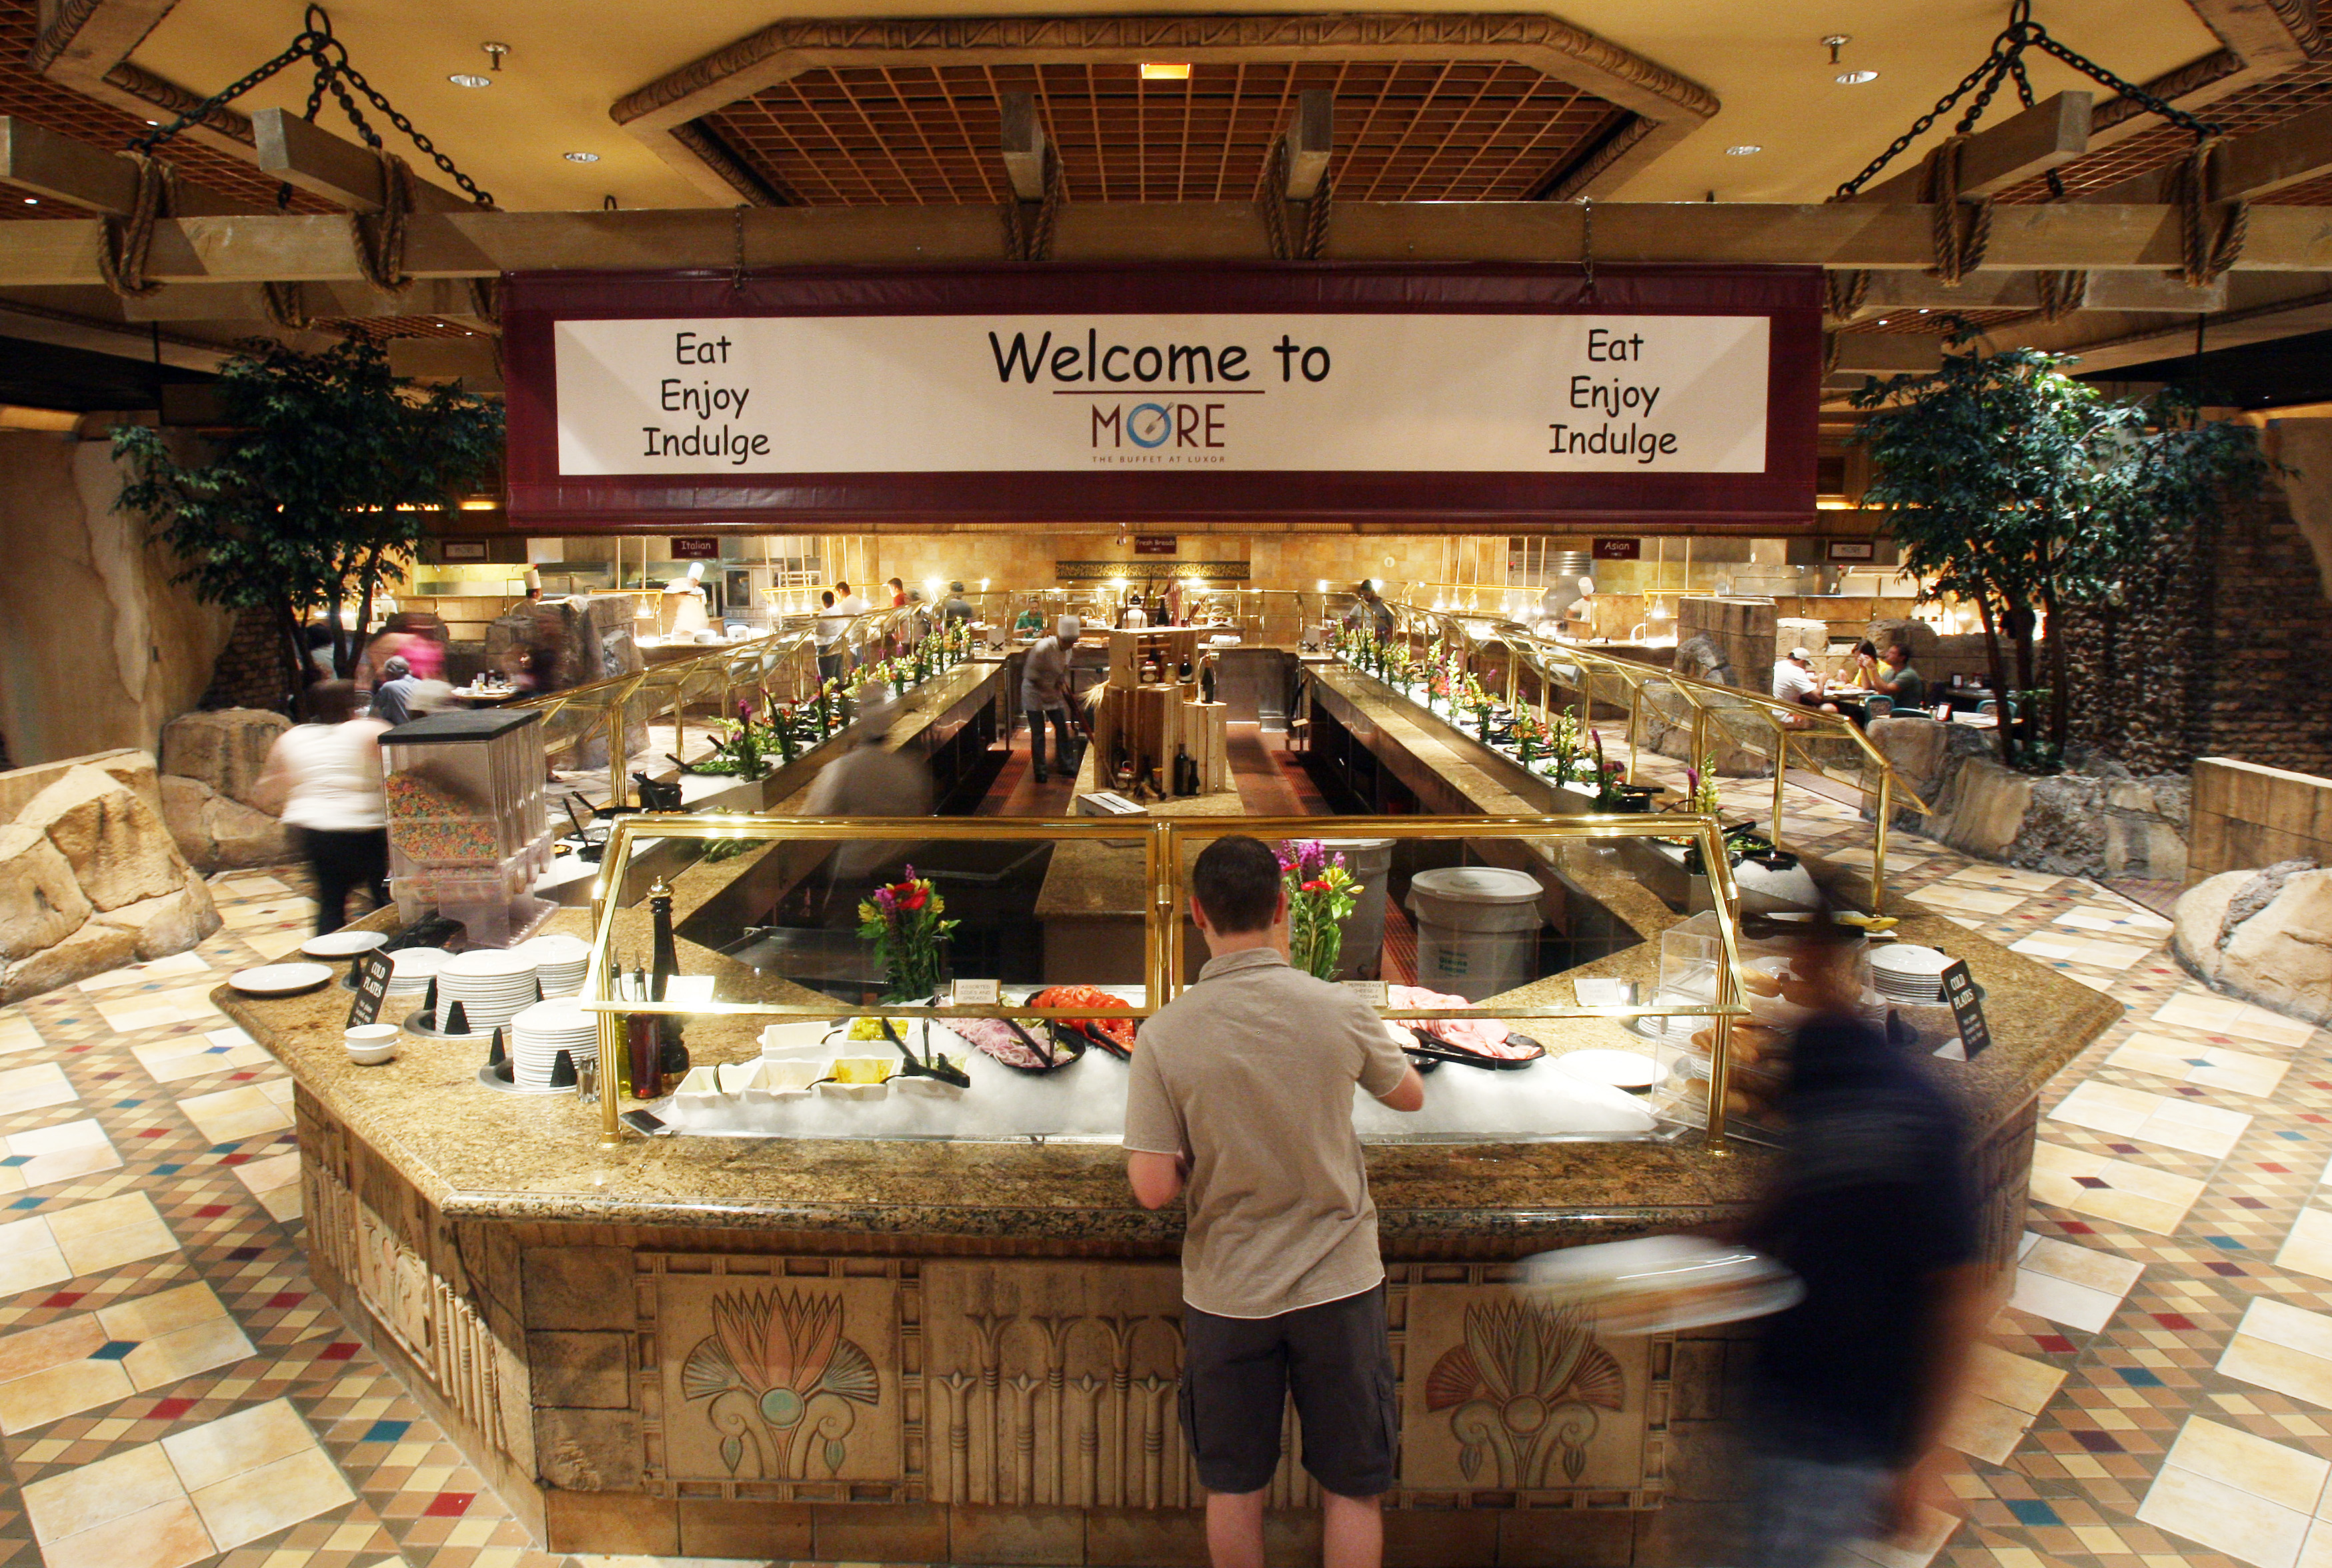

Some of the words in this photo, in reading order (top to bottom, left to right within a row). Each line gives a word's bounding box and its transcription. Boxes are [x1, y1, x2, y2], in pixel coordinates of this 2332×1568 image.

[676, 332, 732, 365] Eat
[988, 327, 1250, 384] Welcome
[1272, 334, 1331, 383] to
[1587, 329, 1644, 361] Eat
[661, 379, 750, 420] Enjoy
[1570, 375, 1660, 418] Enjoy
[1092, 402, 1226, 449] MORE
[642, 424, 770, 465] Indulge
[1120, 455, 1162, 463] BUFFET
[1549, 423, 1678, 464] Indulge
[681, 541, 712, 550] Italian
[1604, 541, 1630, 550] Asian
[371, 961, 385, 979] COLD
[1950, 973, 1966, 990] COLD
[363, 976, 383, 999] PLATES
[1953, 988, 1974, 1009] PLATES
